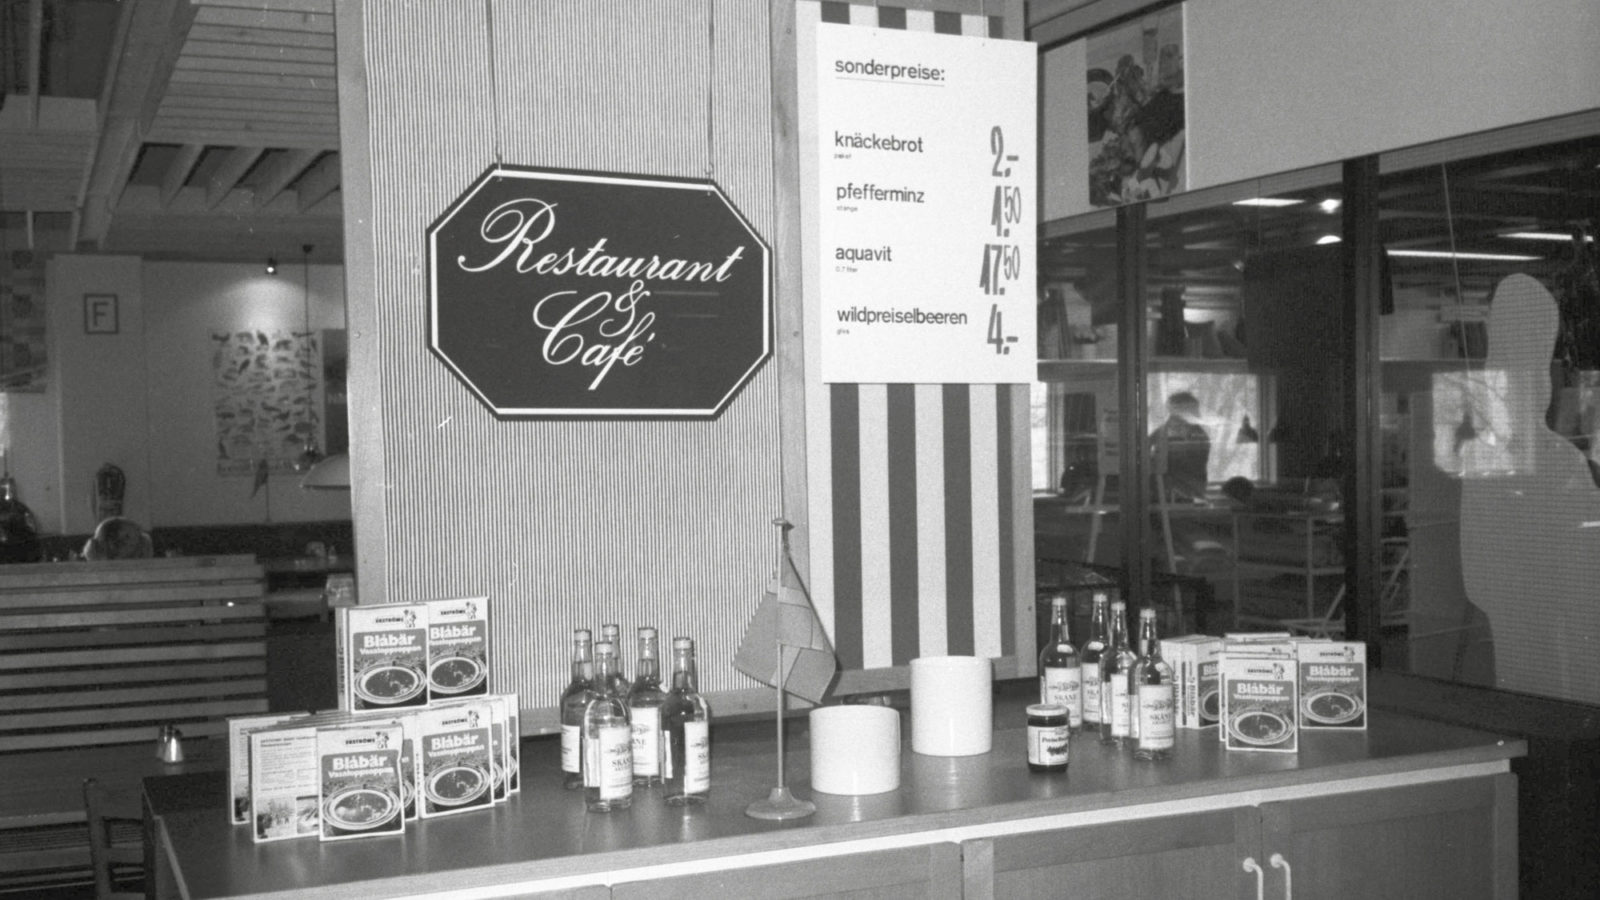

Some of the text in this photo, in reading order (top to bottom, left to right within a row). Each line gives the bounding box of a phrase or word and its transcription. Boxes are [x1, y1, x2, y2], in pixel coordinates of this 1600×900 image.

[835, 59, 945, 81] sonderpreise:
[835, 131, 924, 153] knäckebrot
[836, 182, 925, 204] pfefferminz
[457, 197, 745, 282] Restaurant
[835, 246, 893, 263] aquavit
[93, 302, 109, 327] F
[599, 279, 651, 338] &
[836, 306, 968, 326] wildpreiselbeeren
[532, 290, 656, 391] Café
[363, 633, 416, 648] Blåbär
[430, 624, 477, 640] Blåbär
[1309, 664, 1354, 677] Blåbär
[1237, 682, 1284, 695] Blåbär
[431, 733, 479, 751] Blåbär
[332, 754, 388, 770] Blåbär
